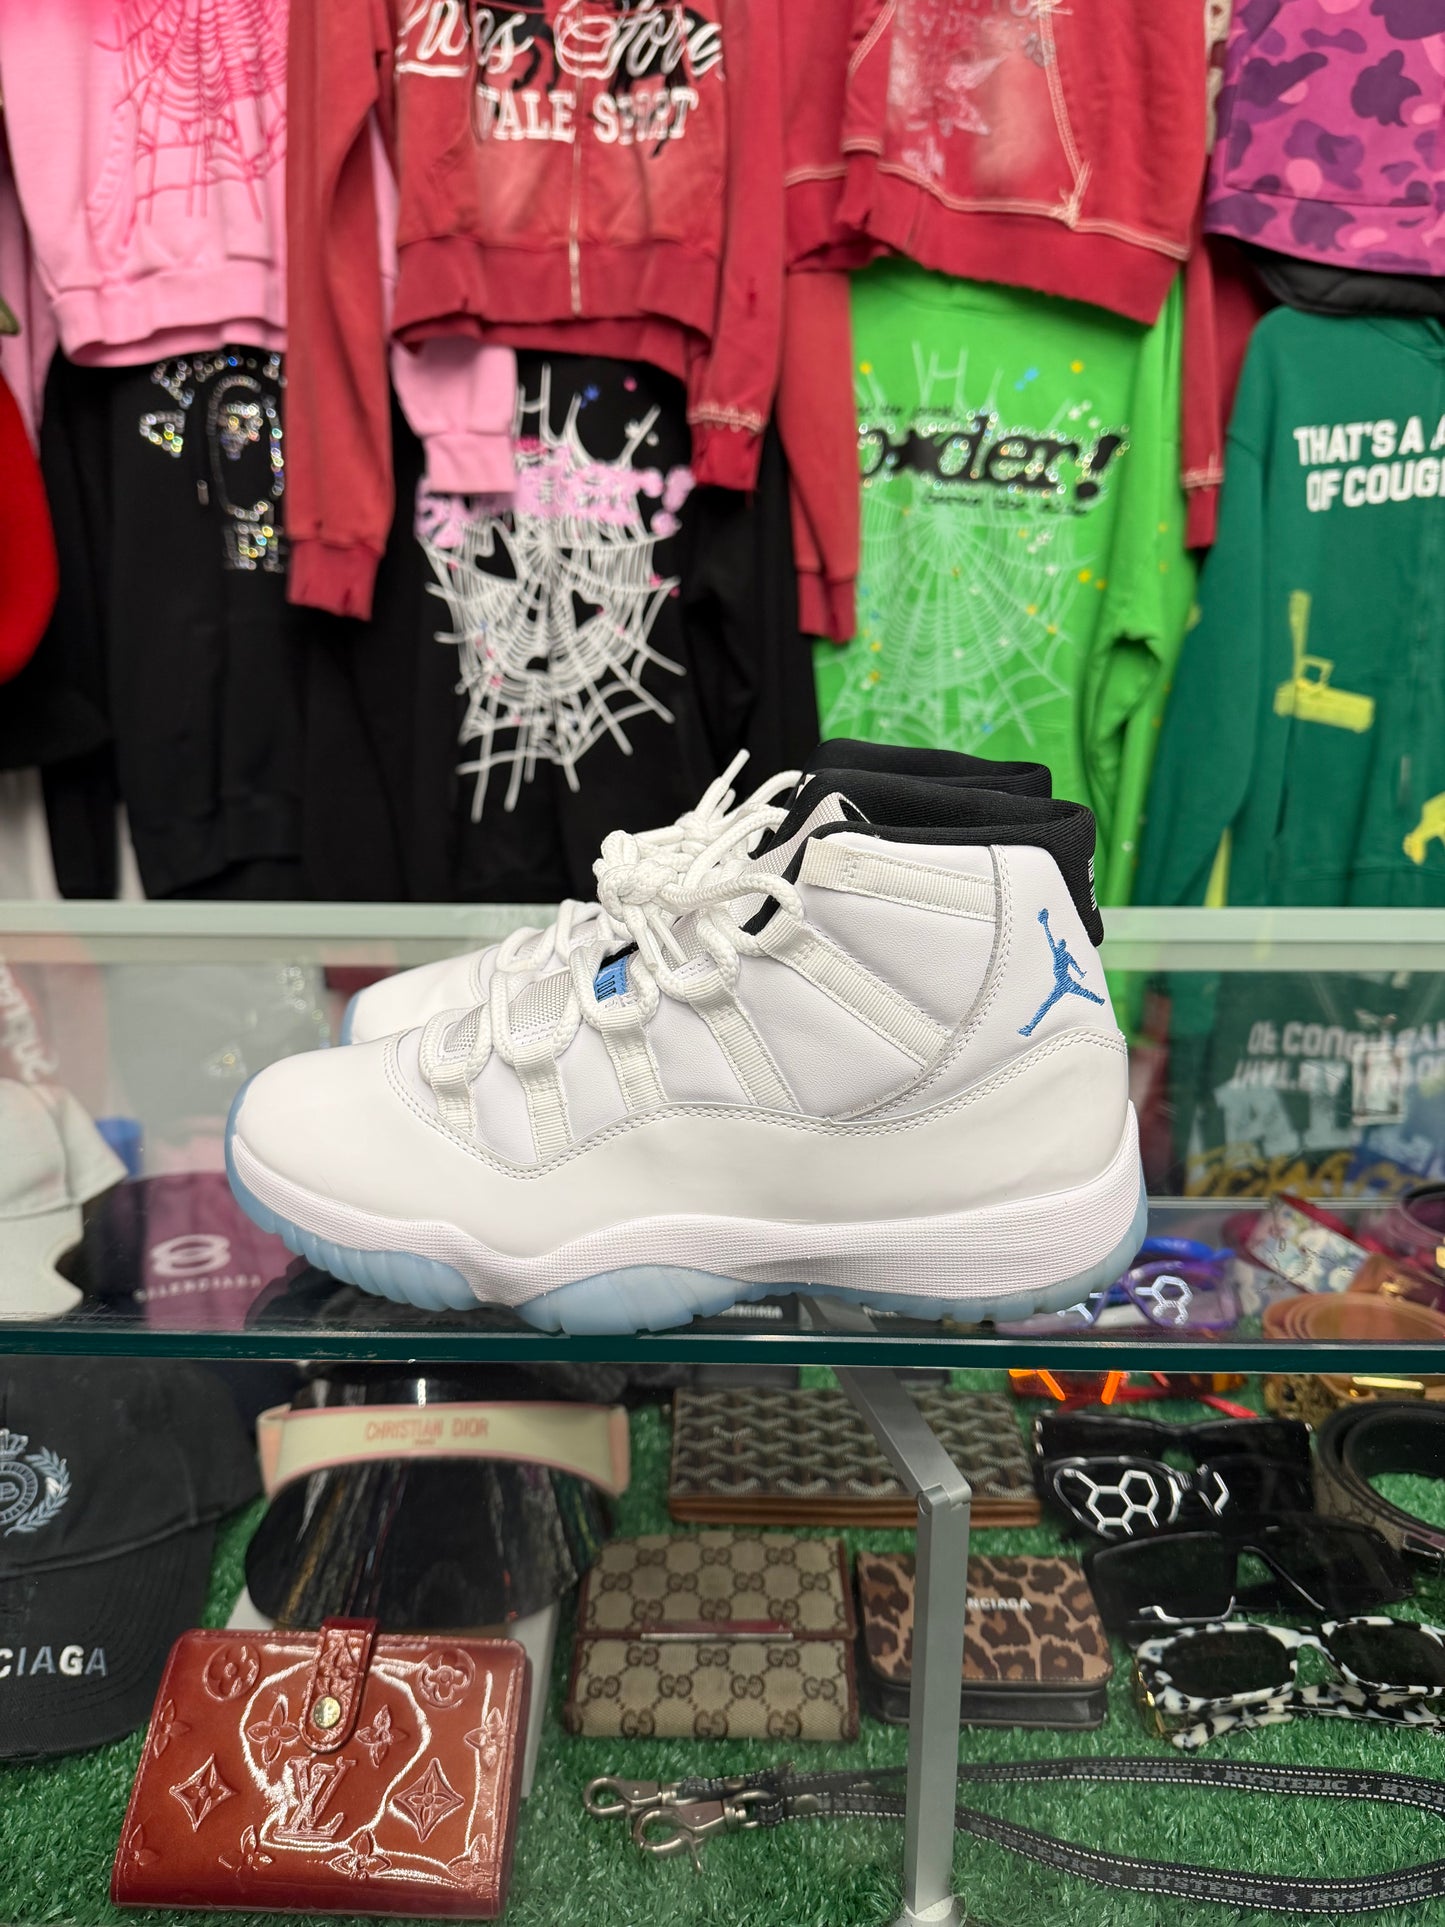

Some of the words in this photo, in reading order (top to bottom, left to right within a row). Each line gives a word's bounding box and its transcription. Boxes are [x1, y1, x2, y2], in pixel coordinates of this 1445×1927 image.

[1293, 417, 1398, 467] THAT'S
[1398, 414, 1426, 456] A
[1306, 467, 1343, 513] OF
[1343, 456, 1445, 508] COUG
[452, 1416, 489, 1438] DIOR
[0, 1644, 107, 1678] CIAGA
[1073, 1763, 1193, 1778] HYSTERIC
[1224, 1769, 1348, 1791] HYSTERIC
[1136, 1872, 1273, 1902] HYSTERIC
[1310, 1877, 1432, 1907] HYSTERIC
